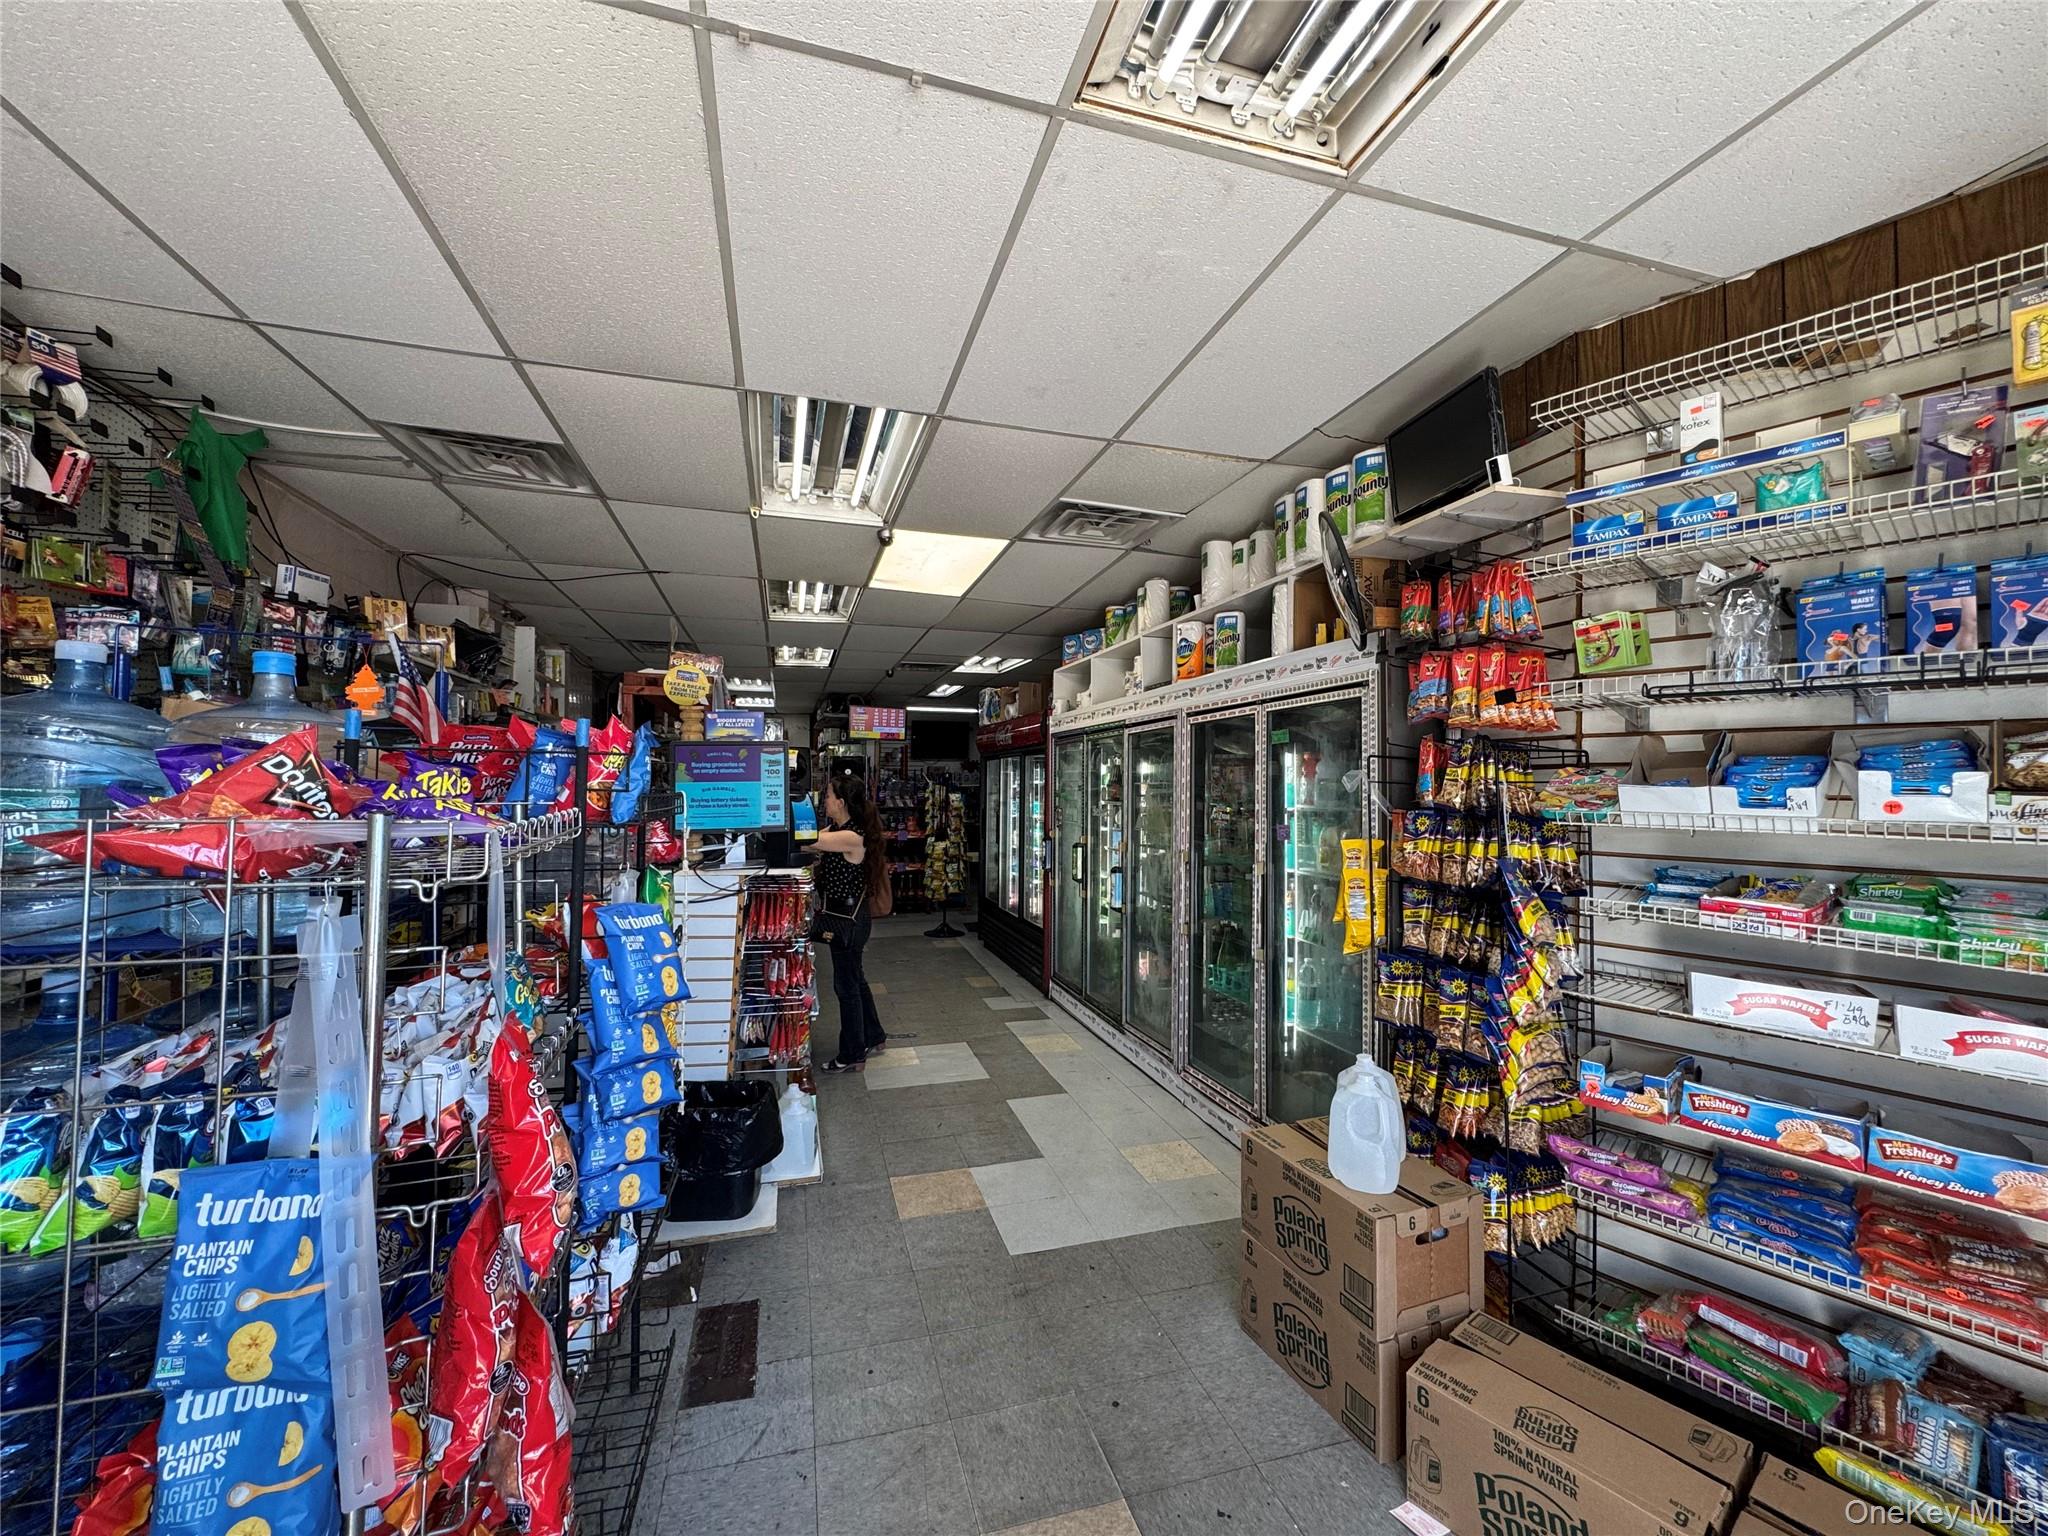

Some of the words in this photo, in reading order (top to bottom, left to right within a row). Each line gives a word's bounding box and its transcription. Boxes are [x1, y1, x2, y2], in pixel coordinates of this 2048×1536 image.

[31, 341, 50, 354] 50
[1812, 436, 1842, 449] TAMPAX
[1709, 461, 1736, 472] TAMPAX
[1586, 527, 1630, 544] TAMPAX
[1850, 596, 1874, 605] WAIST
[260, 753, 340, 820] Doritos
[416, 767, 471, 797] Takis
[1858, 887, 1903, 899] Shirley
[1958, 938, 2021, 954] Shirley
[1743, 995, 1778, 1006] SUGAR
[1780, 1000, 1821, 1016] WAFERS
[1964, 1035, 2011, 1045] SUGAR
[1622, 1097, 1650, 1112] Buns
[1692, 1096, 1747, 1116] Freshley's
[1702, 1118, 1738, 1136] Honey
[1742, 1128, 1771, 1142] Buns
[1246, 1139, 1253, 1155] 6
[1883, 1142, 1953, 1166] Freshley's
[1298, 1169, 1322, 1195] NATURAL
[1896, 1168, 1945, 1190] Honey
[1948, 1181, 1987, 1198] Buns
[1300, 1183, 1321, 1205] WATER
[196, 1190, 325, 1226] turbana
[1273, 1196, 1328, 1247] Poland
[1409, 1216, 1416, 1230] 6
[176, 1239, 254, 1261] PLANTAIN
[1246, 1238, 1253, 1256] 6
[1275, 1222, 1330, 1272] Spring
[183, 1256, 239, 1277] CHIPS
[172, 1281, 235, 1303] LIGHTLY
[169, 1300, 227, 1320] SALTED
[1302, 1295, 1323, 1318] WATER
[1273, 1303, 1329, 1361] Poland
[1411, 1335, 1418, 1350] 6
[1275, 1328, 1331, 1387] Spring
[1414, 1366, 1449, 1392] NATURAL
[1420, 1361, 1449, 1379] WATER
[1417, 1385, 1430, 1408] 6
[1450, 1375, 1479, 1397] SPRING
[1413, 1404, 1440, 1427] GALLON
[1516, 1406, 1580, 1441] Spring
[157, 1430, 241, 1462] PLANTAIN
[1513, 1417, 1578, 1454] Poland
[1913, 1415, 1937, 1466] Vanilla
[1493, 1427, 1524, 1455] 100%
[1525, 1446, 1580, 1489] NATURAL
[1934, 1426, 1949, 1469] cremes
[163, 1450, 227, 1481] CHIPS
[1493, 1442, 1534, 1474] SPRING
[1536, 1466, 1578, 1501] WATER
[157, 1498, 217, 1525] SALTED
